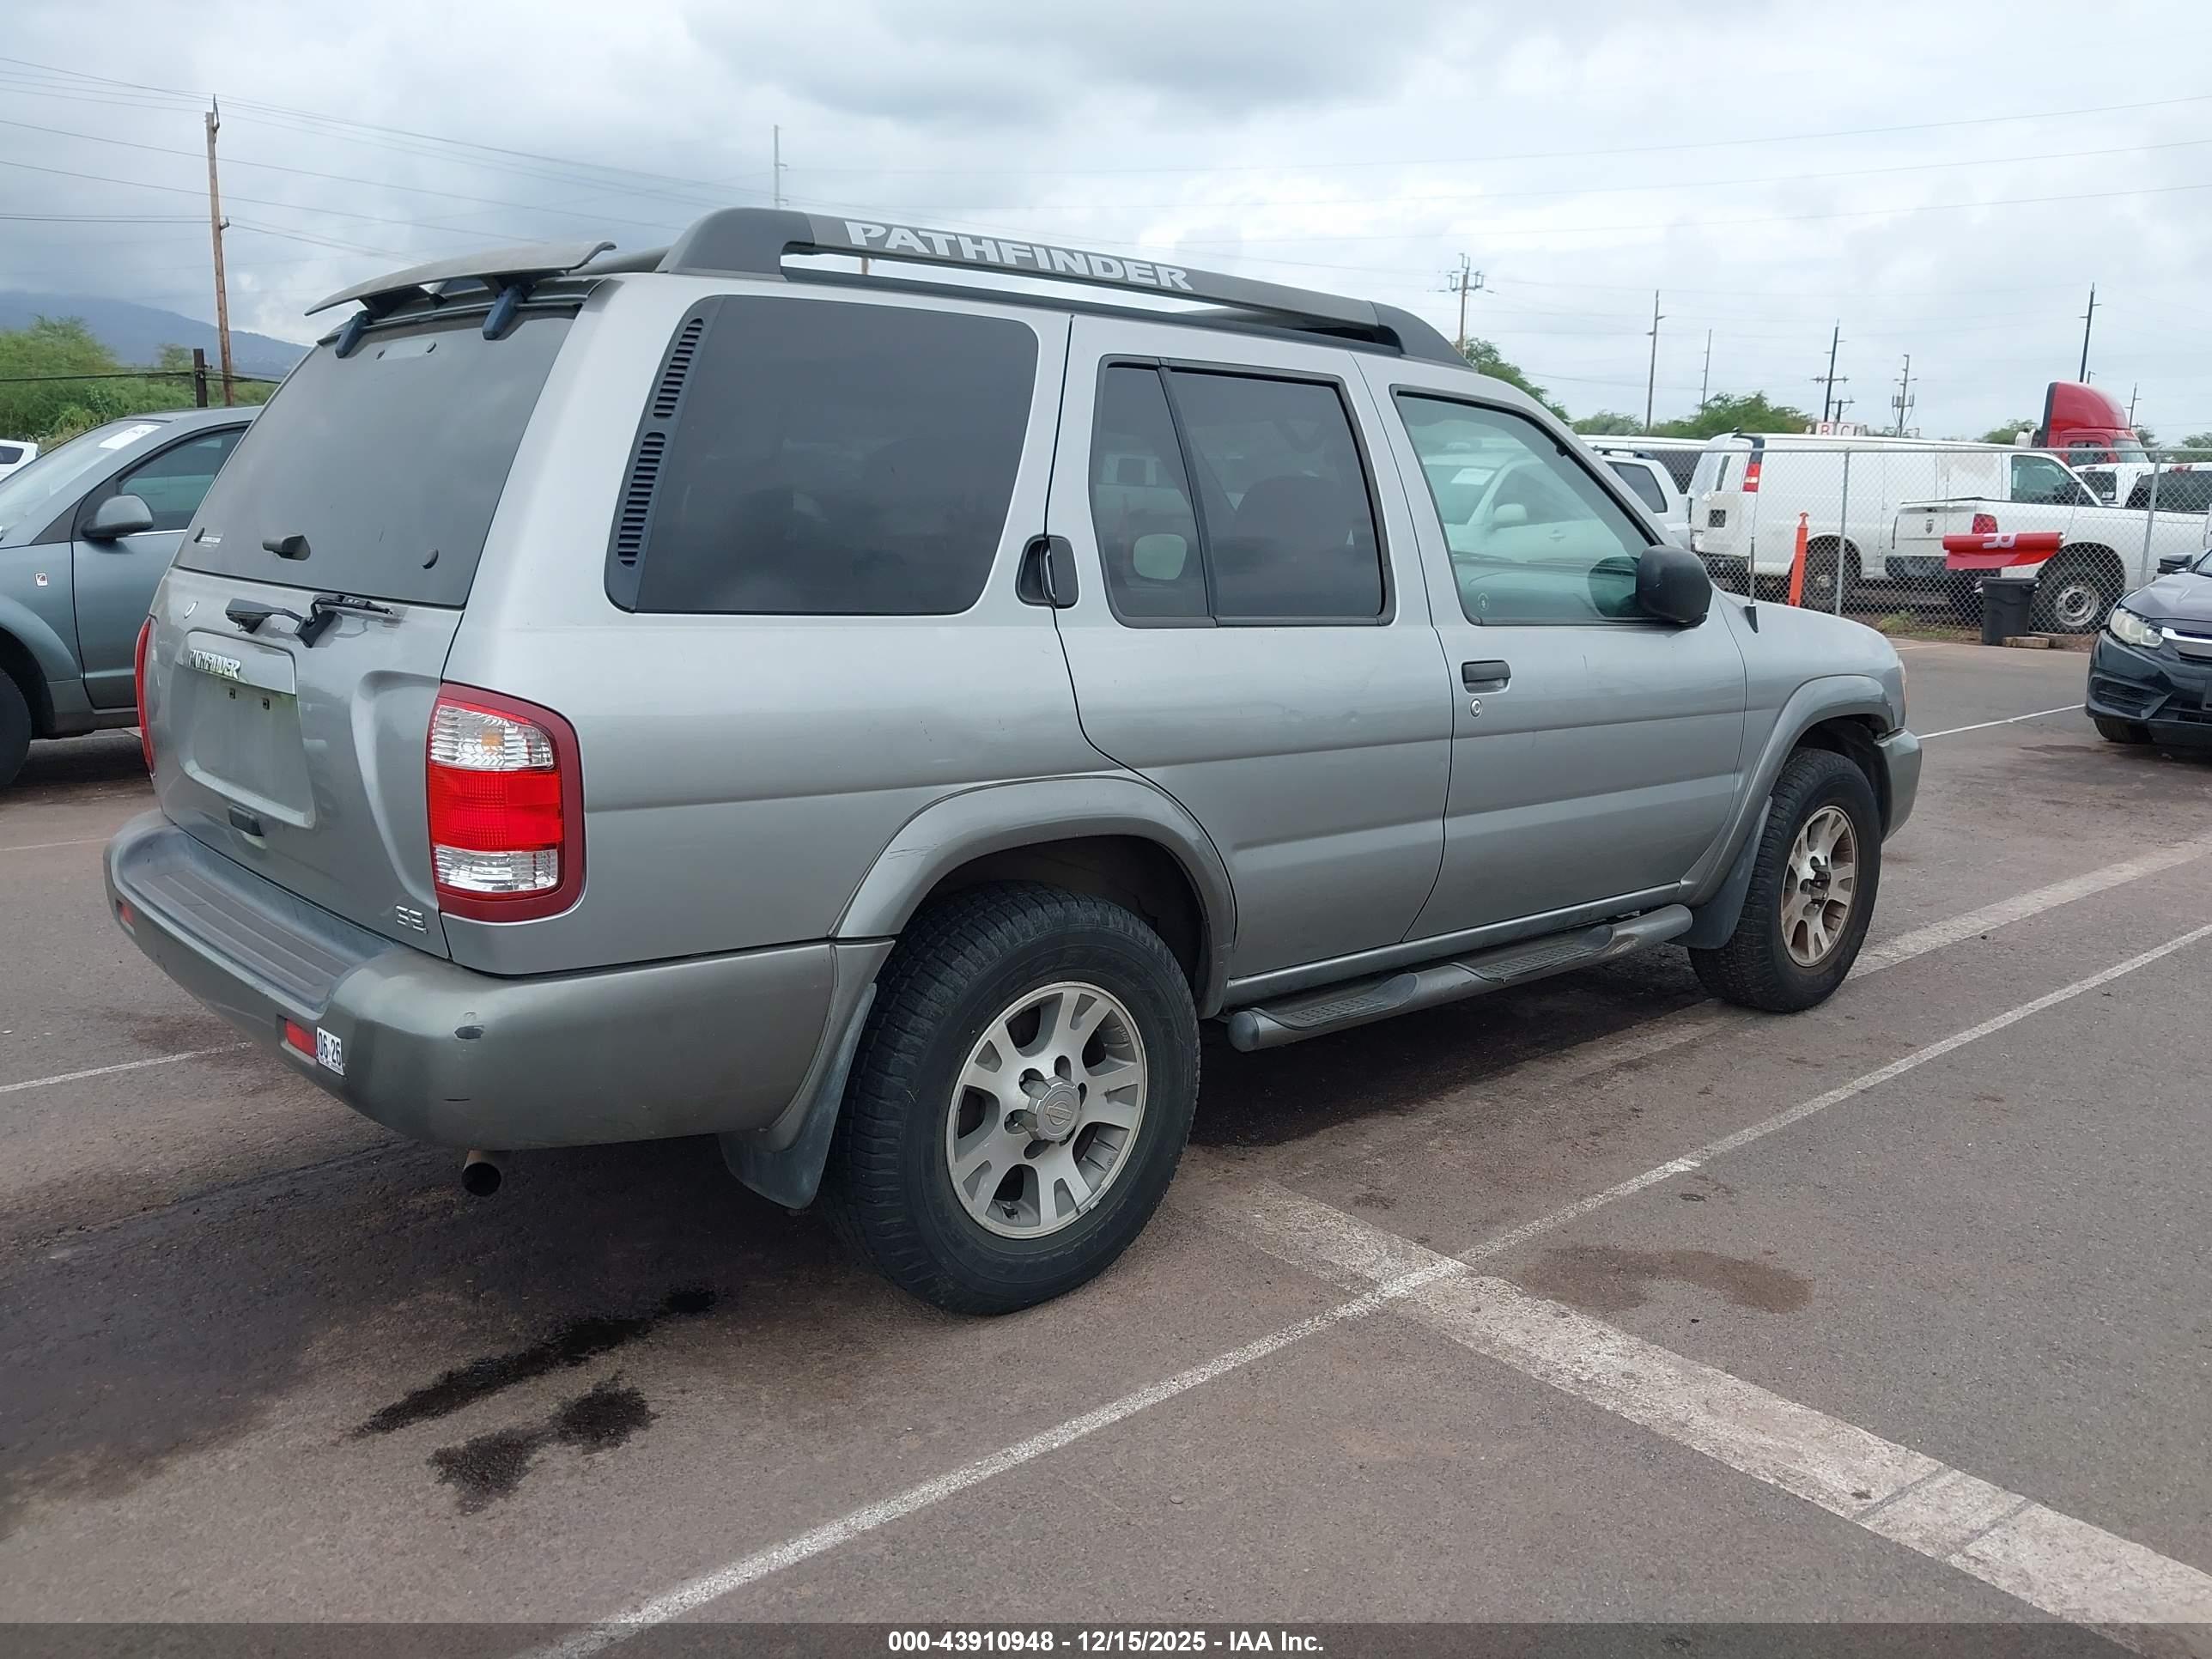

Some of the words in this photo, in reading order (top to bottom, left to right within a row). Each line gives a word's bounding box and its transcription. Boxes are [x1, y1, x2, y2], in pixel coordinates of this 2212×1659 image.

[845, 221, 1193, 290] PATHFINDER
[396, 905, 428, 934] SE
[318, 1031, 328, 1060] 06
[331, 1039, 342, 1066] 26
